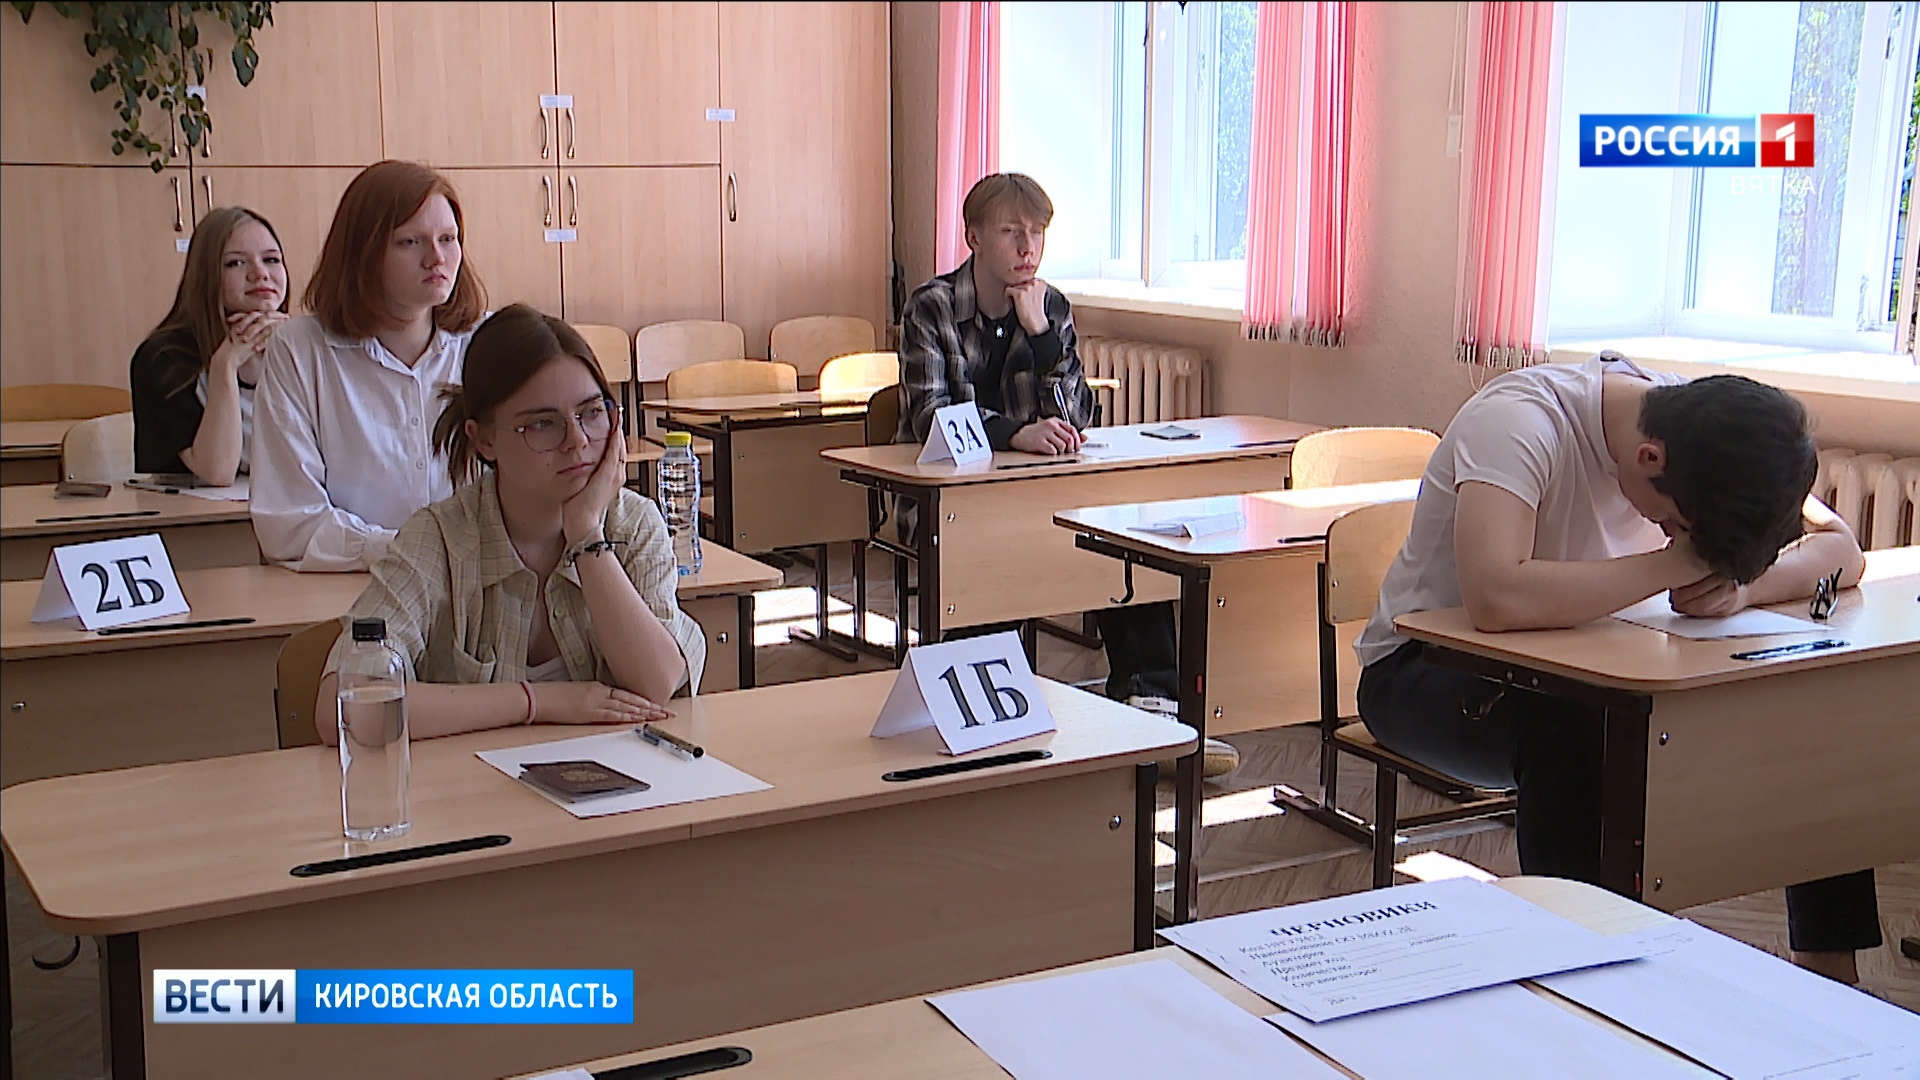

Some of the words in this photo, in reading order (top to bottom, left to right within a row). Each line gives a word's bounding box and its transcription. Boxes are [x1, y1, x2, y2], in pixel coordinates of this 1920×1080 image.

[947, 416, 984, 454] 3А
[80, 555, 165, 614] 2Б
[937, 657, 1029, 730] 1Б
[1268, 900, 1438, 937] ЧЕРНОВИКИ
